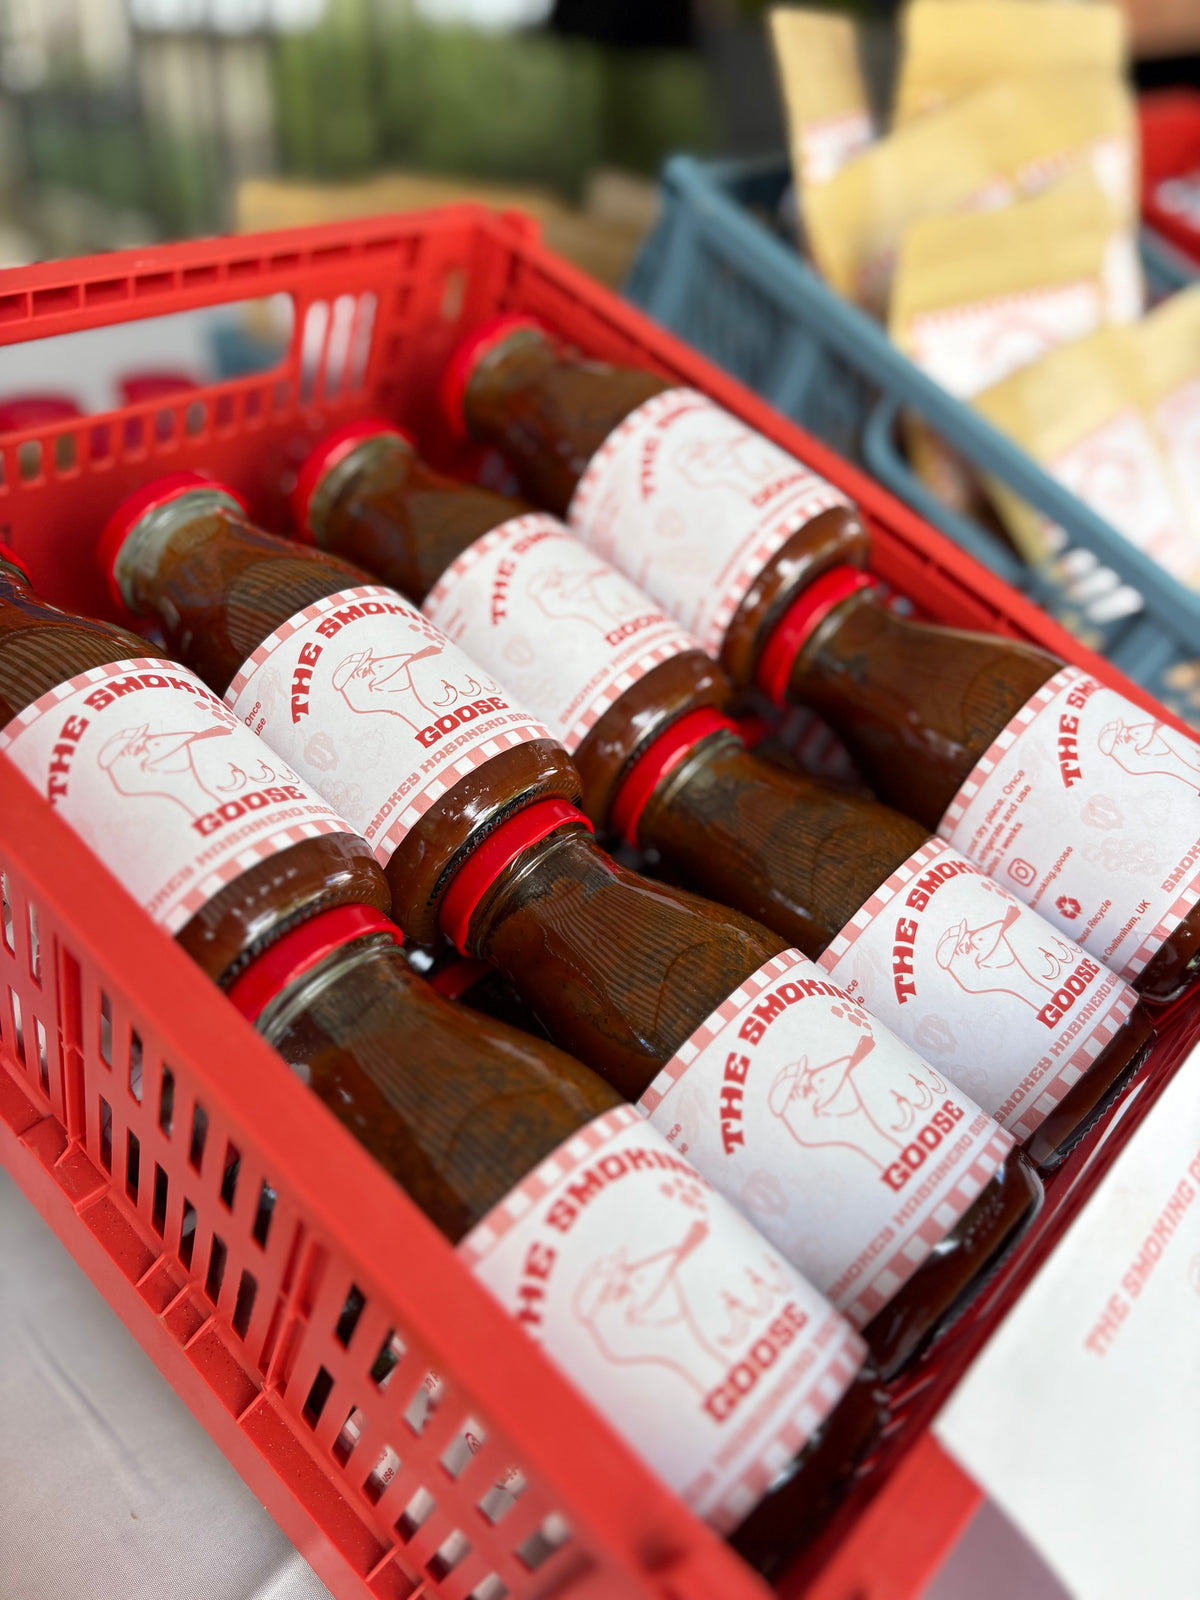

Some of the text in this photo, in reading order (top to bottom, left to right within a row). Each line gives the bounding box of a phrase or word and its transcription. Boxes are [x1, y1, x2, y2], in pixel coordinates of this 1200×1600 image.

[291, 641, 324, 724] THE
[315, 602, 448, 639] SMOKIN
[48, 674, 238, 804] THE SMOKIN
[244, 701, 261, 727] Once
[254, 717, 266, 736] use
[414, 696, 510, 749] GOOSE
[1057, 713, 1083, 788] THE
[191, 785, 307, 838] GOOSE
[364, 772, 421, 841] SMOKEY
[422, 716, 508, 775] HABANERO
[1002, 769, 1025, 796] Once
[1003, 802, 1018, 822] and
[1016, 785, 1031, 803] use
[1002, 822, 1023, 849] weeks
[1160, 837, 1200, 893] SMOK
[1087, 899, 1111, 929] Recycle
[1104, 916, 1141, 956] Cheltenham,
[1135, 899, 1151, 914] UK
[892, 917, 919, 1005] THE
[1035, 957, 1101, 1030] GOOSE
[719, 979, 876, 1155] THE SMOKIN
[991, 1055, 1053, 1124] SMOKEY
[1048, 983, 1111, 1060] HABANERO
[881, 1099, 965, 1192] GOOSE
[515, 1242, 557, 1326] HE
[1083, 1178, 1196, 1358] THE SMOKING
[701, 1301, 809, 1424] GOOSE
